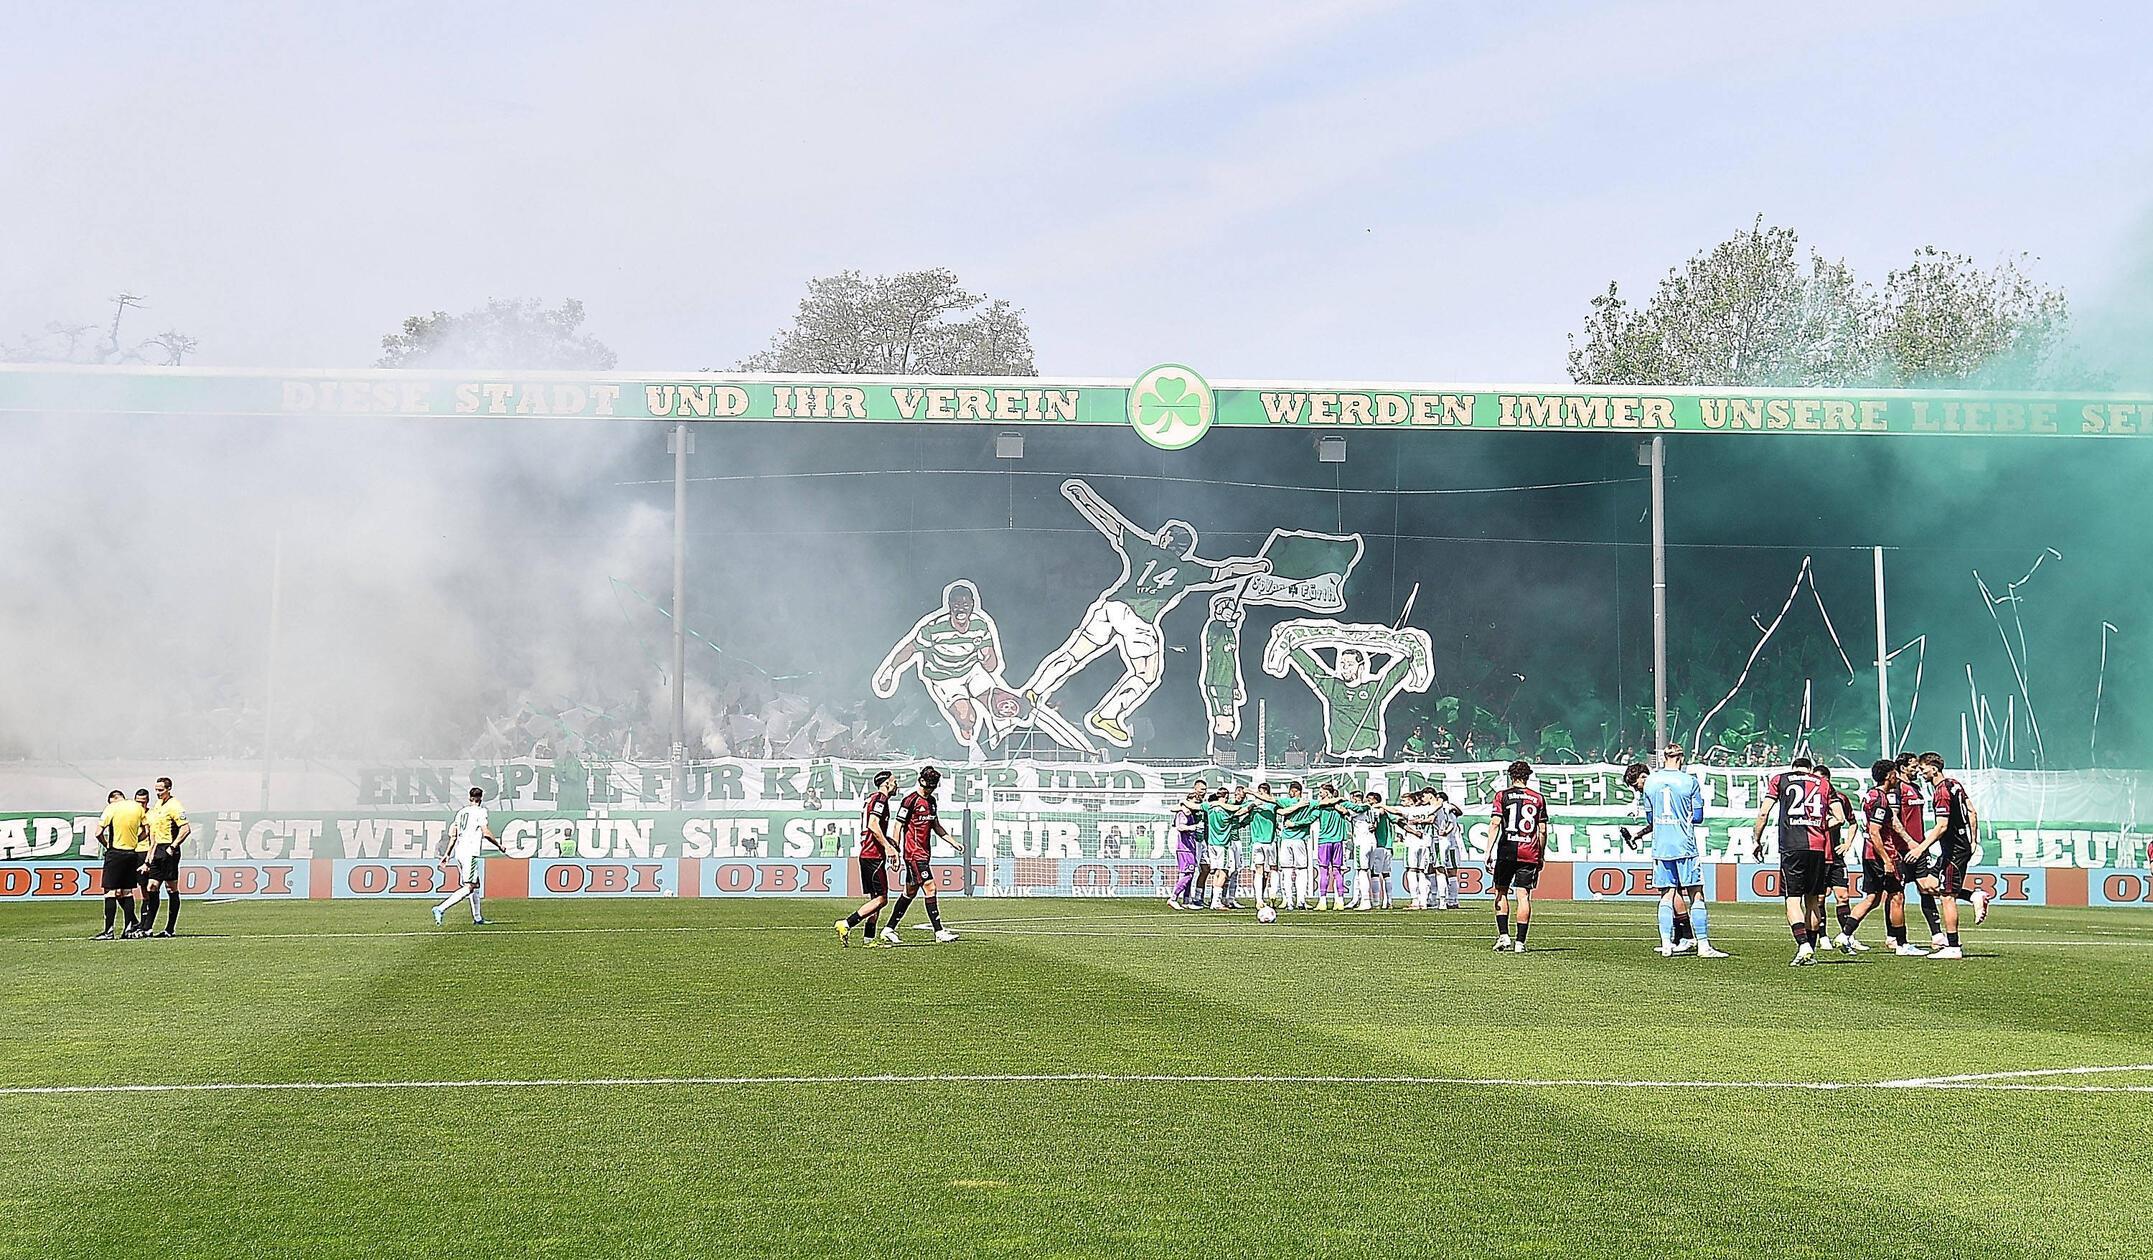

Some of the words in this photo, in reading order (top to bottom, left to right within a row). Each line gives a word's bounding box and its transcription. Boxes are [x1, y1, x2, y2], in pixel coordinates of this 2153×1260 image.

[281, 381, 430, 412] DIESE
[455, 383, 620, 415] STADT
[645, 385, 749, 417] UND
[773, 386, 867, 418] IHR
[891, 387, 1080, 421] VEREIN
[1260, 391, 1476, 426] WERDEN
[1498, 394, 1676, 429] IMMER
[1699, 397, 1888, 431] UNSERE
[1912, 401, 2058, 433] LIEBE
[1136, 559, 1178, 588] 14
[356, 767, 455, 804] EIN
[469, 763, 622, 804] SPIL
[639, 760, 746, 804] FÜR
[759, 757, 1018, 803] KÄMPER
[1036, 767, 1145, 806] UND
[1660, 787, 1673, 816] 1
[1785, 783, 1824, 817] 24
[1505, 802, 1537, 833] 18
[682, 818, 768, 859] SIE
[975, 811, 1083, 858] FÜR
[1997, 828, 2153, 869] HEUT
[0, 866, 103, 897] OBI
[181, 865, 293, 895] OBI
[348, 864, 464, 894] OBI
[545, 864, 662, 893] OBI
[715, 864, 832, 892] OBI
[1588, 867, 1661, 895] OB
